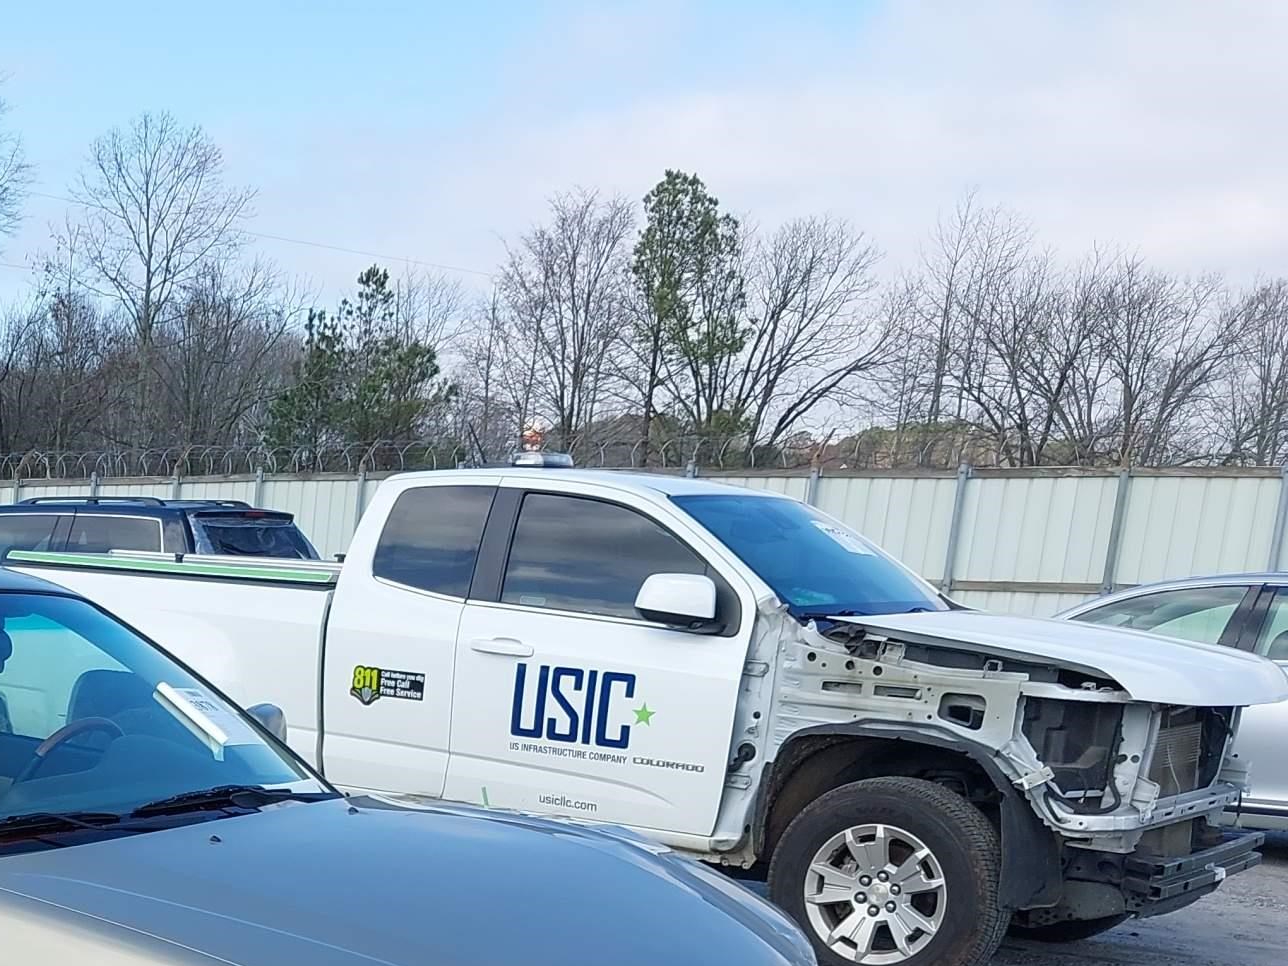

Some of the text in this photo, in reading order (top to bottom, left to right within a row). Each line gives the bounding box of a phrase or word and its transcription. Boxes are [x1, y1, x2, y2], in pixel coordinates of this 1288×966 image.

[354, 667, 378, 690] 811
[381, 679, 410, 689] Free Call
[380, 687, 422, 699] Free Service
[511, 663, 636, 749] USIC
[509, 742, 627, 764] US INFRASTRUCTURE COMPANY
[632, 757, 705, 773] COLORADO
[539, 794, 598, 812] usicllc.com
